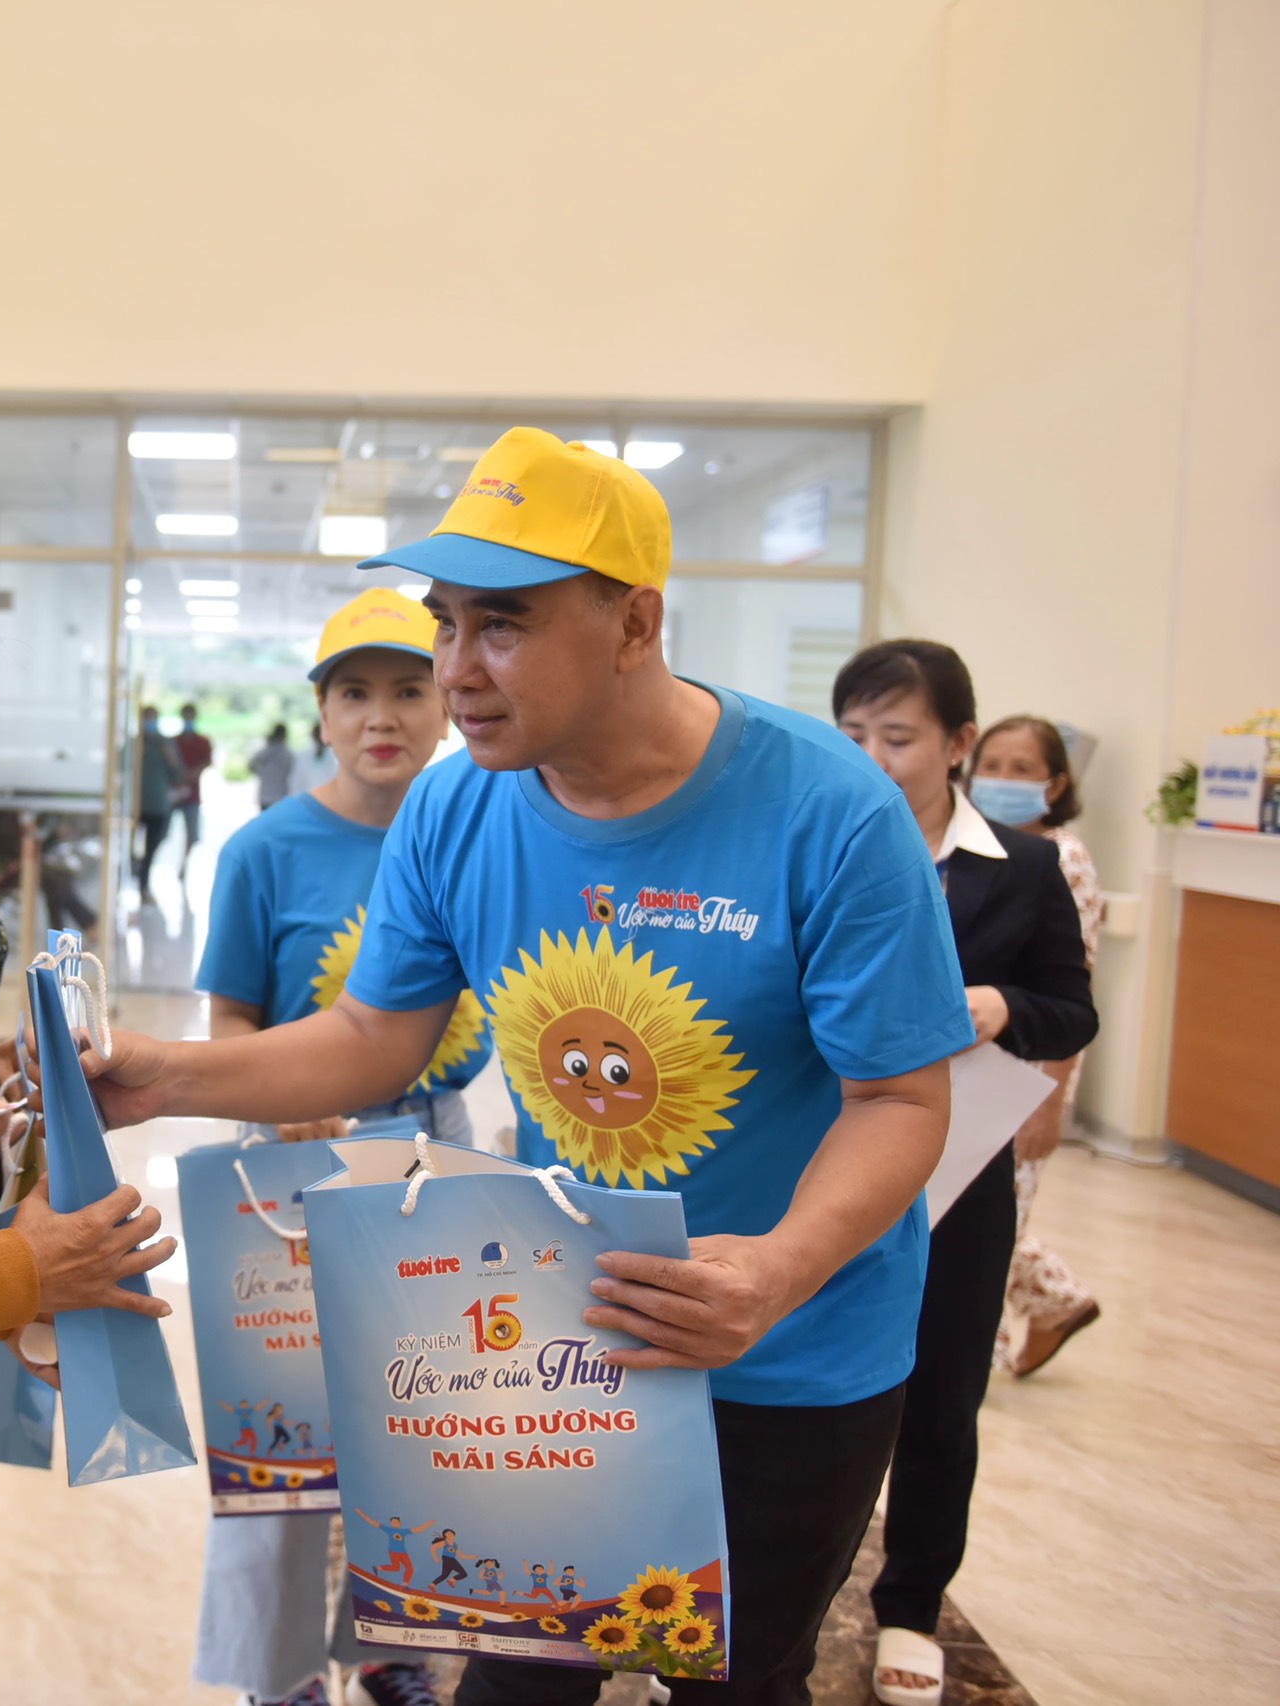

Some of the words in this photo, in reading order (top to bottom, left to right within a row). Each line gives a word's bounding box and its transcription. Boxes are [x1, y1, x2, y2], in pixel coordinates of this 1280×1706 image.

[579, 884, 616, 925] 15
[674, 912, 697, 930] của
[698, 896, 760, 941] Thúy
[234, 1307, 313, 1329] HƯỚNG
[421, 1331, 462, 1351] NIỆM
[460, 1293, 523, 1354] 15
[517, 1340, 538, 1351] năm
[387, 1354, 445, 1401] Ước
[447, 1367, 489, 1393] mơ
[493, 1359, 535, 1390] của
[536, 1338, 626, 1396] Thúy
[386, 1412, 506, 1438] HƯỚNG
[514, 1407, 637, 1435] DƯƠNG
[431, 1445, 495, 1471] MÃI
[504, 1443, 596, 1470] SÁNG
